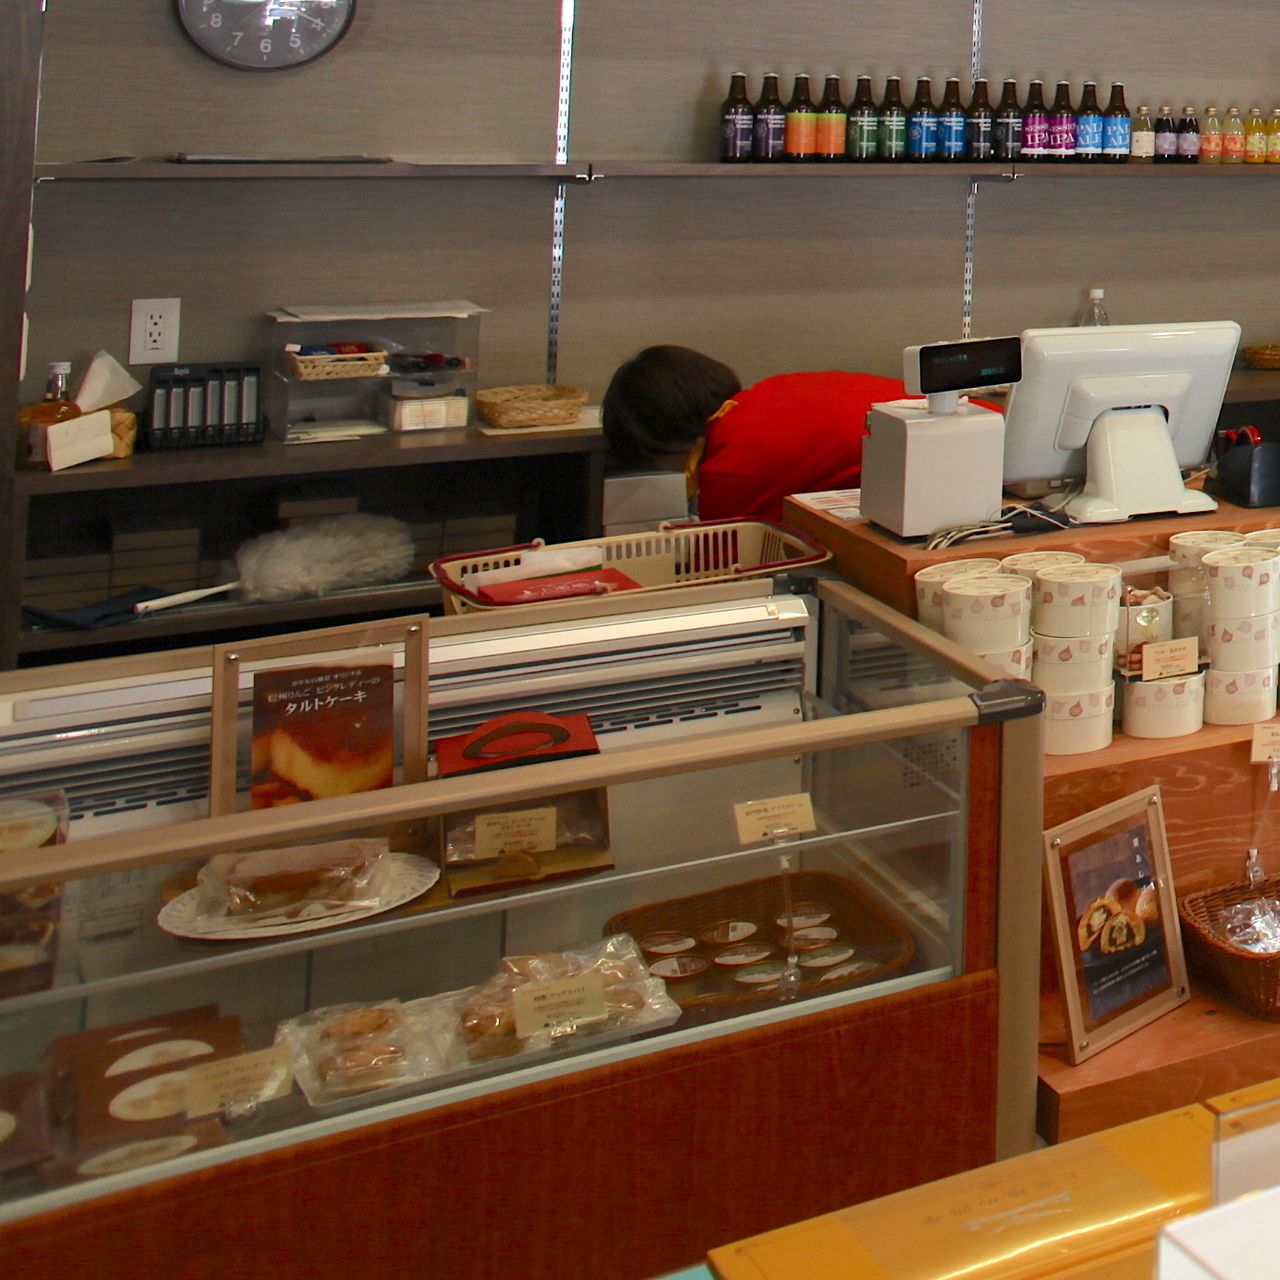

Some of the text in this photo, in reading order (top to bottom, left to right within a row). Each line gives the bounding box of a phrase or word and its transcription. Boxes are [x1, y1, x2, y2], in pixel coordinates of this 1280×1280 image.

[210, 13, 223, 29] 8
[232, 32, 244, 47] 7
[259, 38, 273, 53] 6
[289, 34, 301, 48] 5
[1050, 133, 1075, 145] IPA
[267, 688, 311, 703] 信州りんご
[285, 690, 367, 717] タルトケーキ
